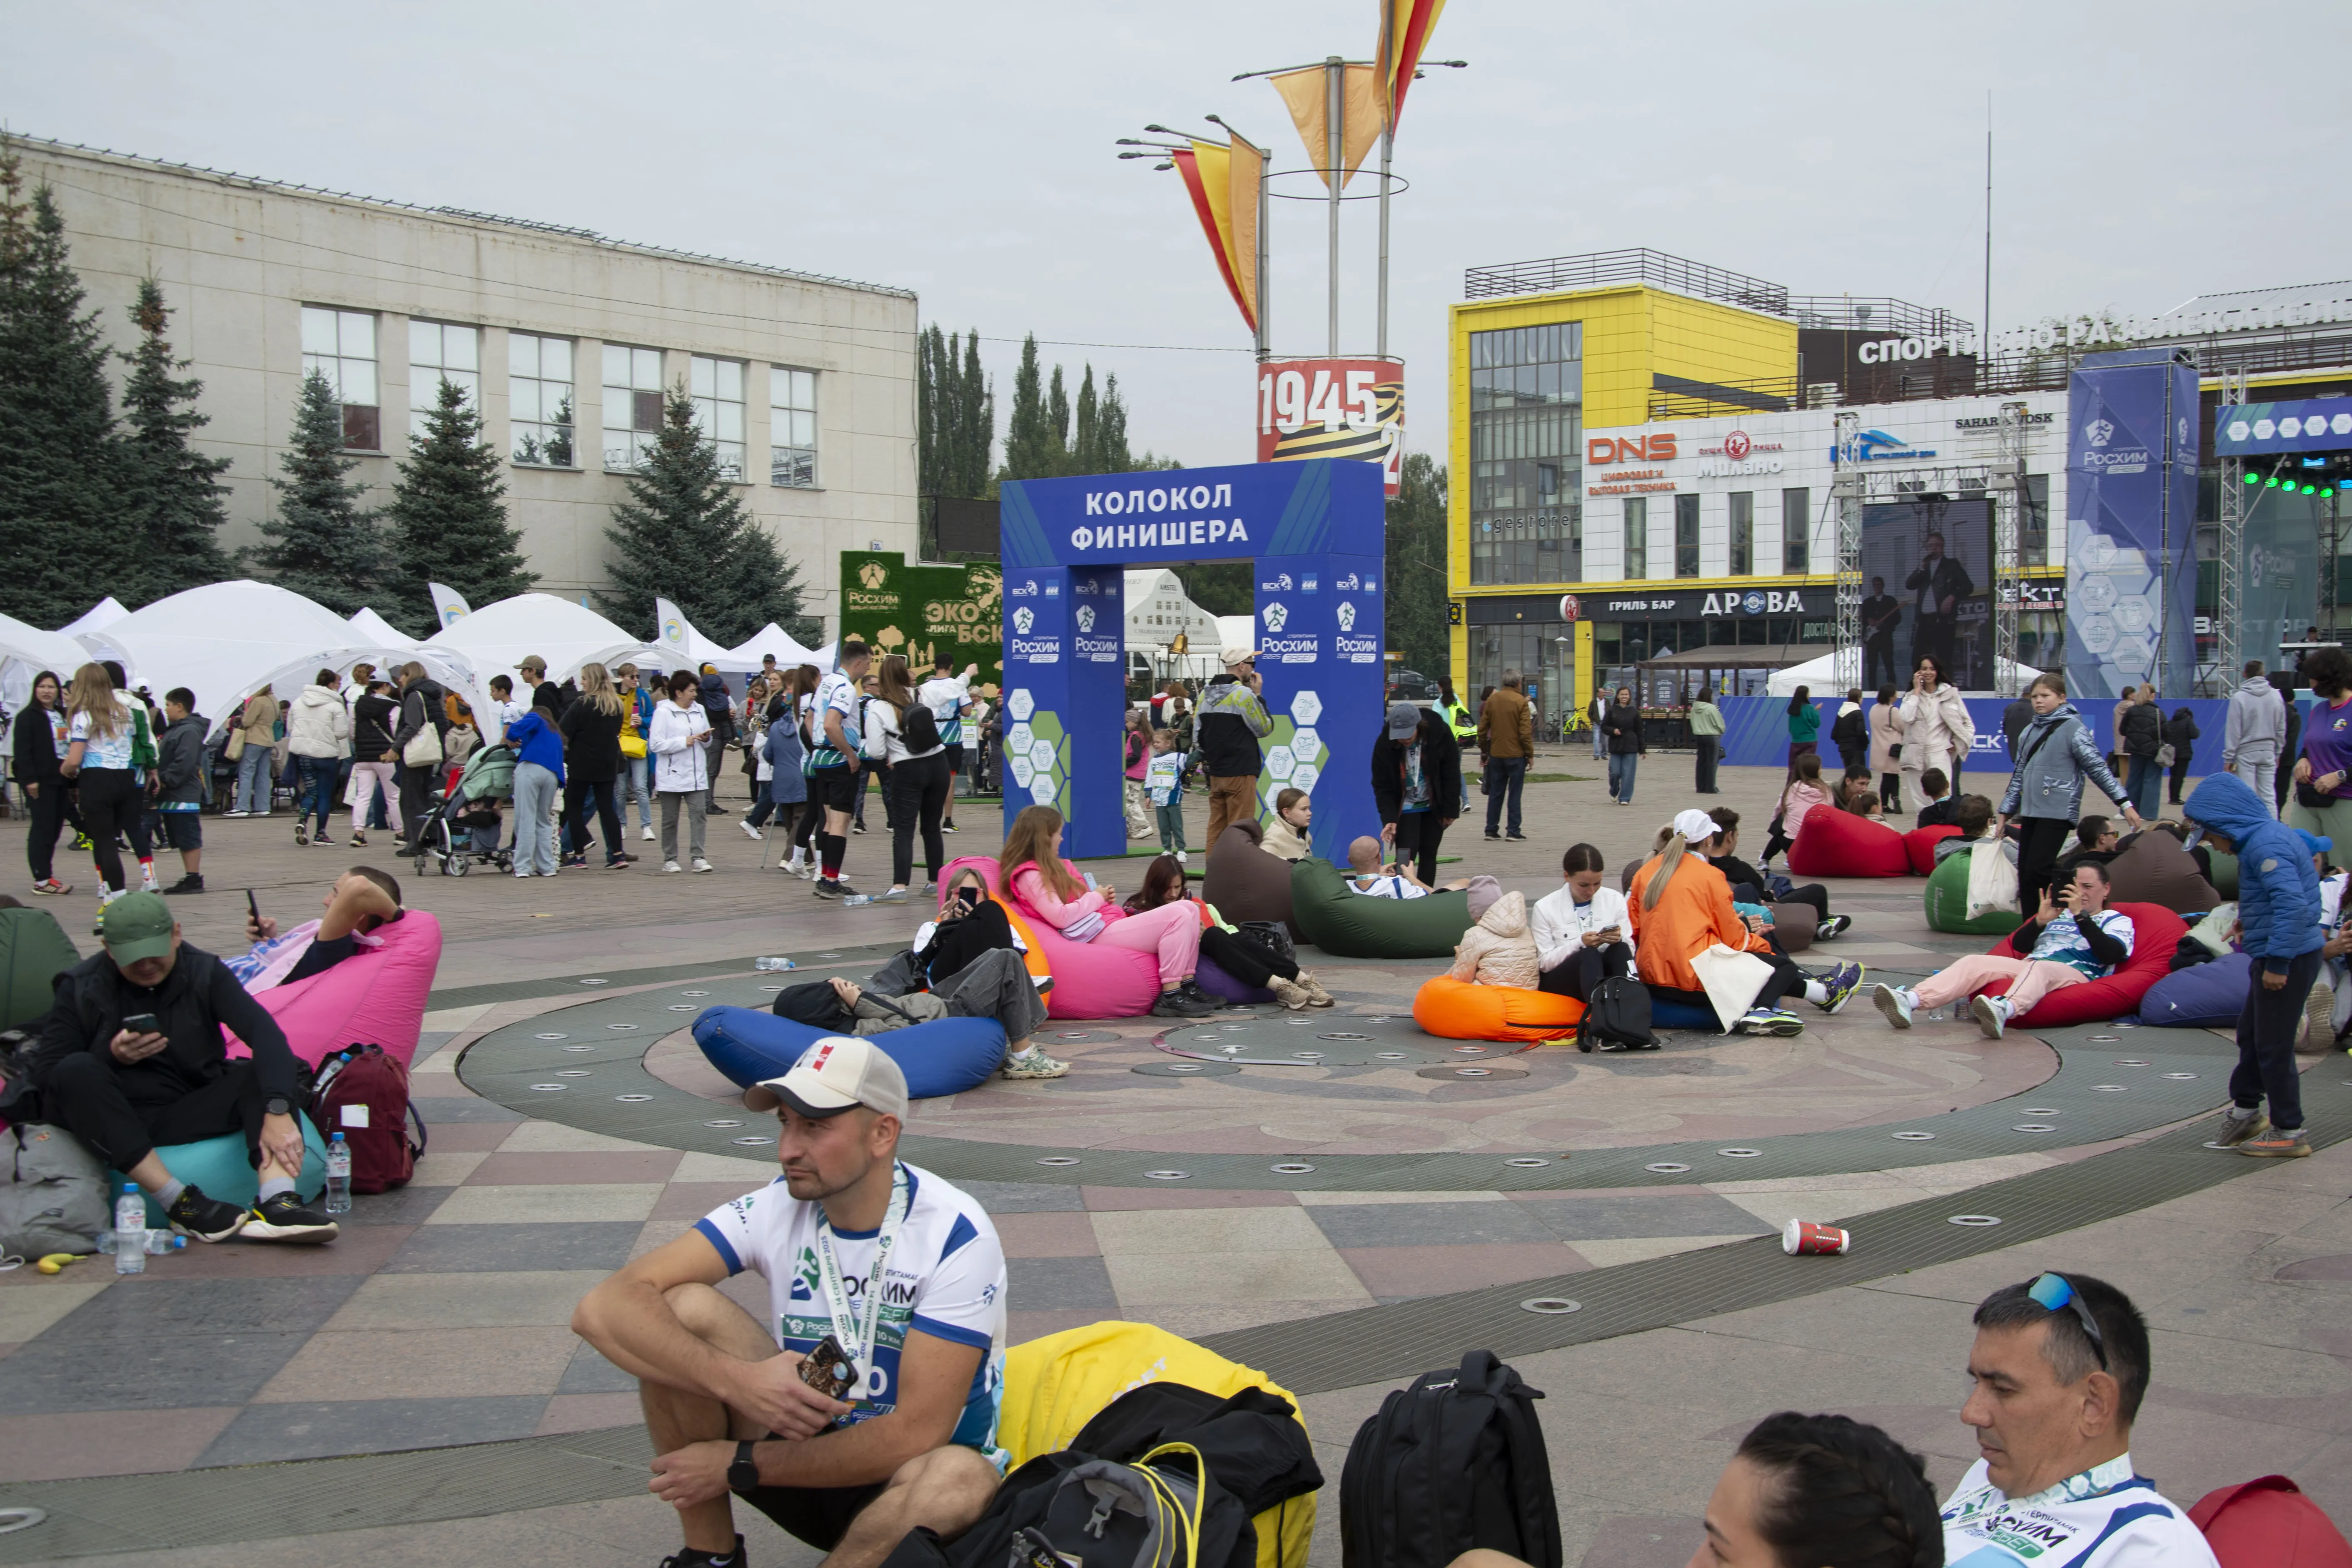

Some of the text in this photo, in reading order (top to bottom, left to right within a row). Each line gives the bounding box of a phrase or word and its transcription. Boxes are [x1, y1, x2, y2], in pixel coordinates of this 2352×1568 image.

[1259, 370, 1377, 434] 1945
[1955, 417, 1999, 429] SAHAR
[1380, 421, 1404, 485] 2
[1589, 433, 1677, 464] DNS
[1601, 470, 1654, 482] ЦИФРОВАЯ
[1589, 481, 1677, 496] БЫТОВАЯ ТЕХНИКА
[1086, 484, 1232, 515] КОЛОКОЛ
[1071, 519, 1249, 550] ФИНИШЕРА
[925, 603, 979, 622] ЭКО
[1609, 600, 1676, 611] ГРИЛЬ БАР
[958, 624, 1004, 643] БСК
[1803, 623, 1836, 638] ДОСТАВ
[1970, 735, 2003, 748] СК
[821, 1235, 831, 1253] 2025
[826, 1255, 841, 1298] СЕНТЯБРЯ
[806, 1321, 833, 1331] Росхи
[862, 1299, 873, 1341] СЕНТЯБРЯ
[876, 1330, 887, 1340] 10
[1112, 1356, 1166, 1401] ORT
